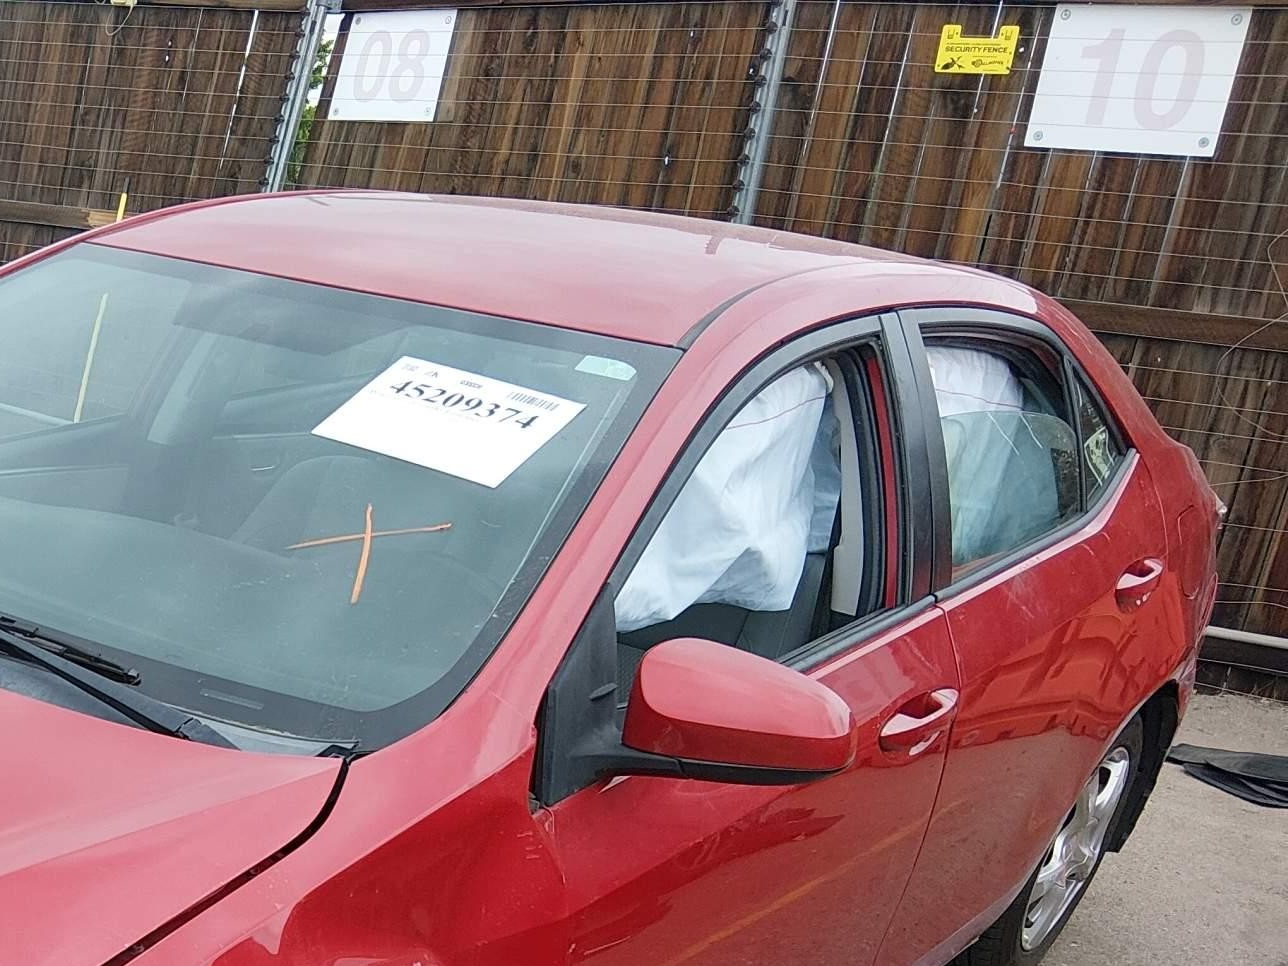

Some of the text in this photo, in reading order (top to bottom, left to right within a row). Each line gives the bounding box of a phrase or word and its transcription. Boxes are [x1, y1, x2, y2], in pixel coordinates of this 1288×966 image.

[354, 29, 430, 102] 08
[945, 45, 1009, 54] SECURITY FENCE
[1080, 28, 1206, 131] 10
[389, 380, 540, 429] 45209374
